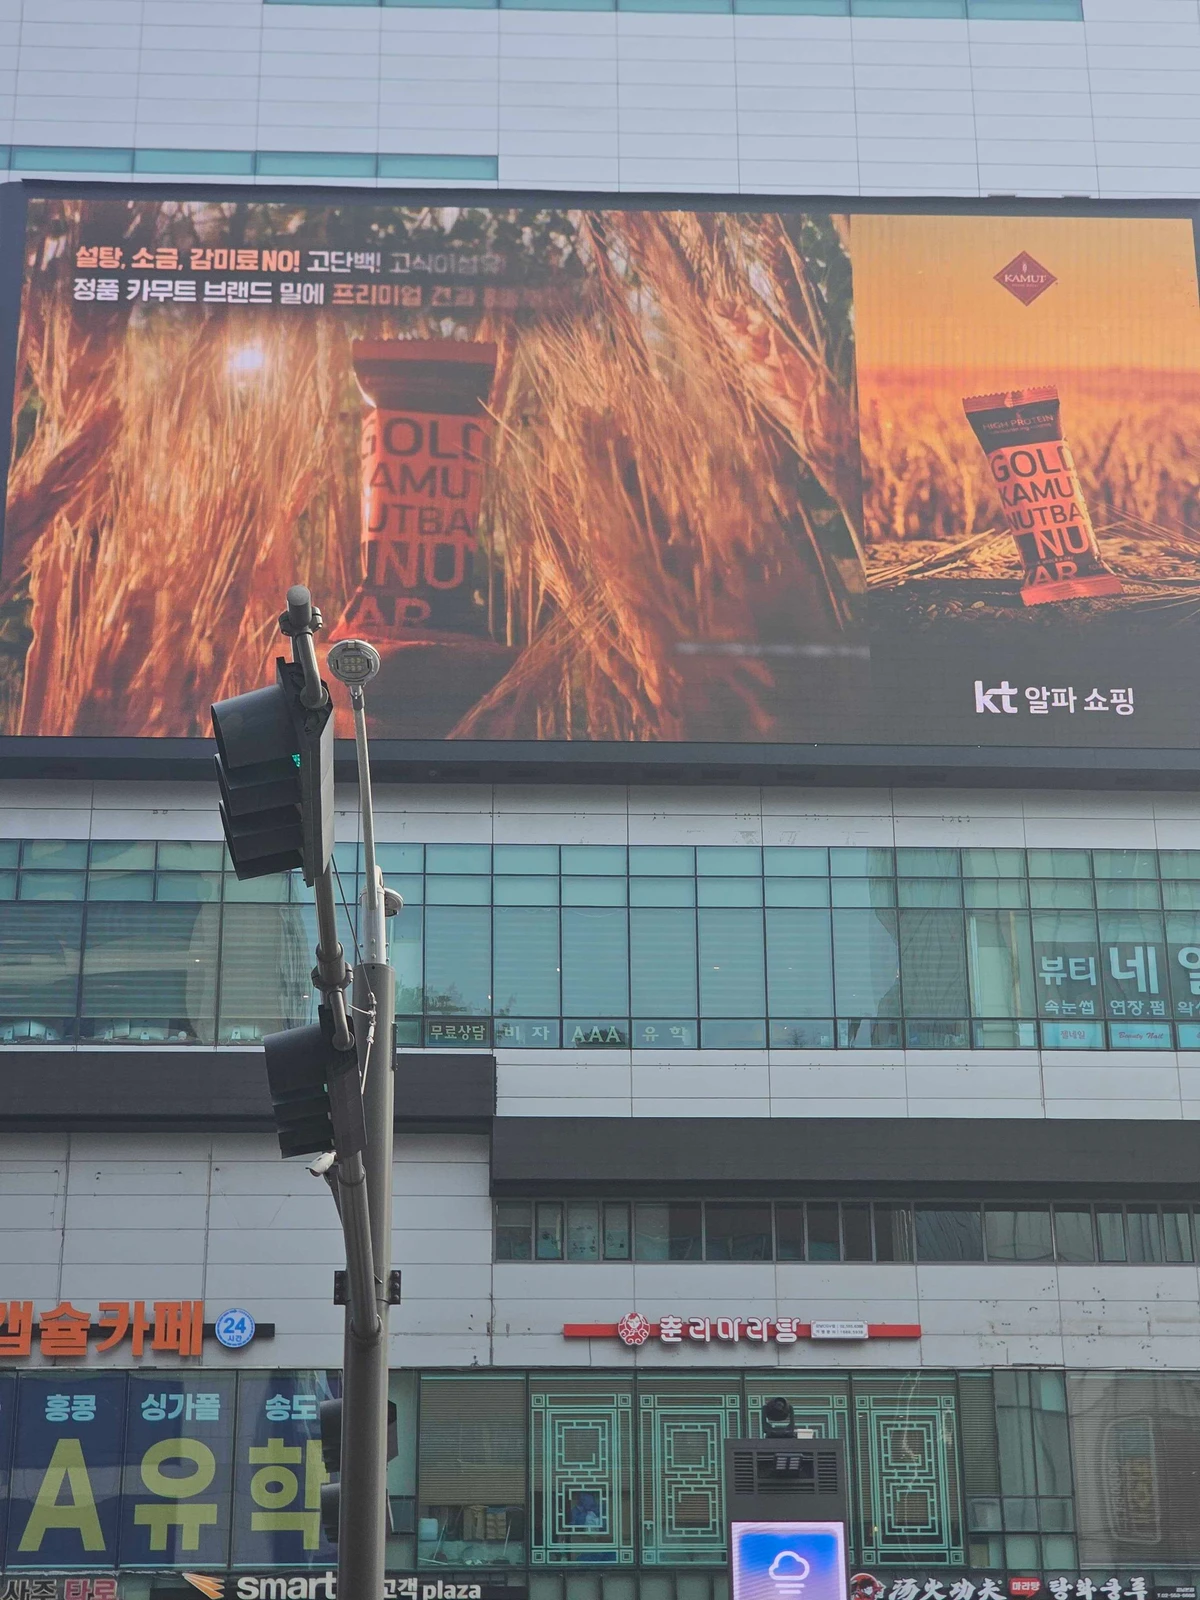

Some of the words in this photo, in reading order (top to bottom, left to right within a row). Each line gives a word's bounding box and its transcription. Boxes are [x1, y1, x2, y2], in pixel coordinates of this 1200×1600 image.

[76, 246, 126, 270] 설탕,
[131, 247, 184, 271] 소금,
[190, 248, 259, 271] 감미료
[262, 250, 300, 273] NO!
[306, 250, 381, 274] 고단백!
[73, 278, 120, 302] 정품
[126, 278, 197, 303] 카무트
[203, 281, 273, 304] 브랜드
[280, 282, 325, 306] 밀에
[974, 680, 1018, 714] kt
[1025, 686, 1077, 714] 알파
[1083, 687, 1134, 716] 쇼핑
[1039, 956, 1096, 986] 뷰티
[1044, 1000, 1095, 1015] 속눈썹
[430, 1025, 486, 1041] 무료상담
[571, 1025, 621, 1043] AAA
[1118, 1031, 1144, 1040] Beauty
[1145, 1032, 1164, 1040] Nail
[223, 1317, 247, 1334] 24
[228, 1335, 242, 1343] 시간
[45, 1393, 96, 1422] 홍콩
[141, 1393, 221, 1422] 싱가폴
[265, 1394, 318, 1422] 송도
[18, 1438, 107, 1552] A
[134, 1437, 331, 1551] 유학
[236, 1571, 336, 1600] smart
[423, 1579, 481, 1600] plaza
[1012, 1581, 1041, 1592] 마라탕
